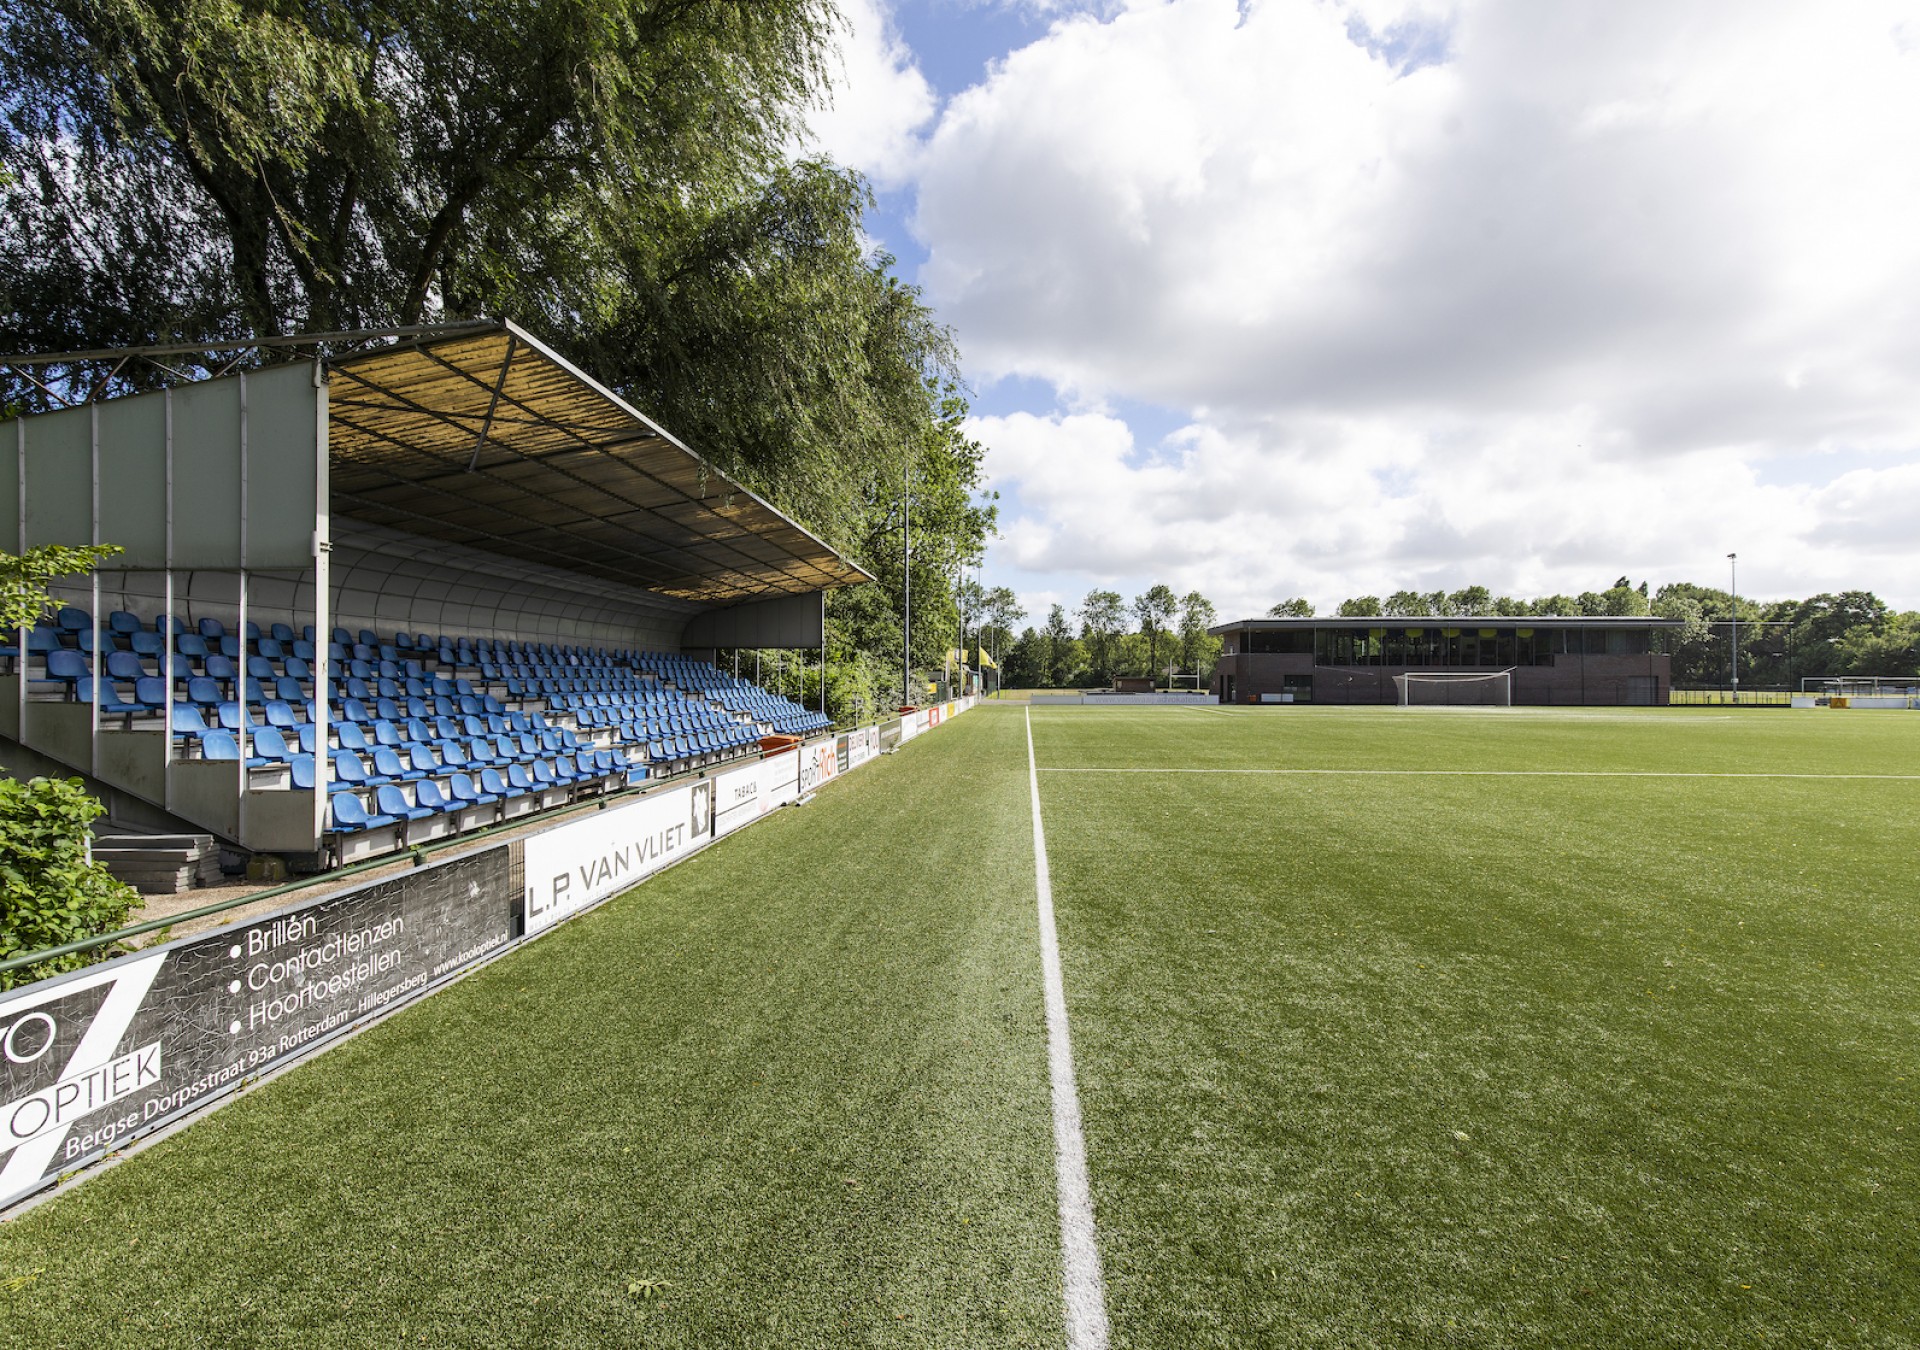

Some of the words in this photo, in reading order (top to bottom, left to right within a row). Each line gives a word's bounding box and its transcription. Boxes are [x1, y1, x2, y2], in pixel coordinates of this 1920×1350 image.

[529, 872, 571, 918] L.P.
[580, 846, 630, 891] VAN
[636, 822, 685, 864] VLIET
[248, 916, 404, 991] Contactlenzen
[248, 950, 401, 1030] Hoortoestellen
[65, 1111, 139, 1160] Bergse
[144, 1057, 246, 1122] Dorpsstraat
[249, 1044, 276, 1067] 93a
[279, 1010, 348, 1053] Rotterdam
[358, 971, 428, 1014] Hillegersberg
[433, 928, 508, 977] www.kooloptiek.nl
[9, 1046, 158, 1139] OPTIEK
